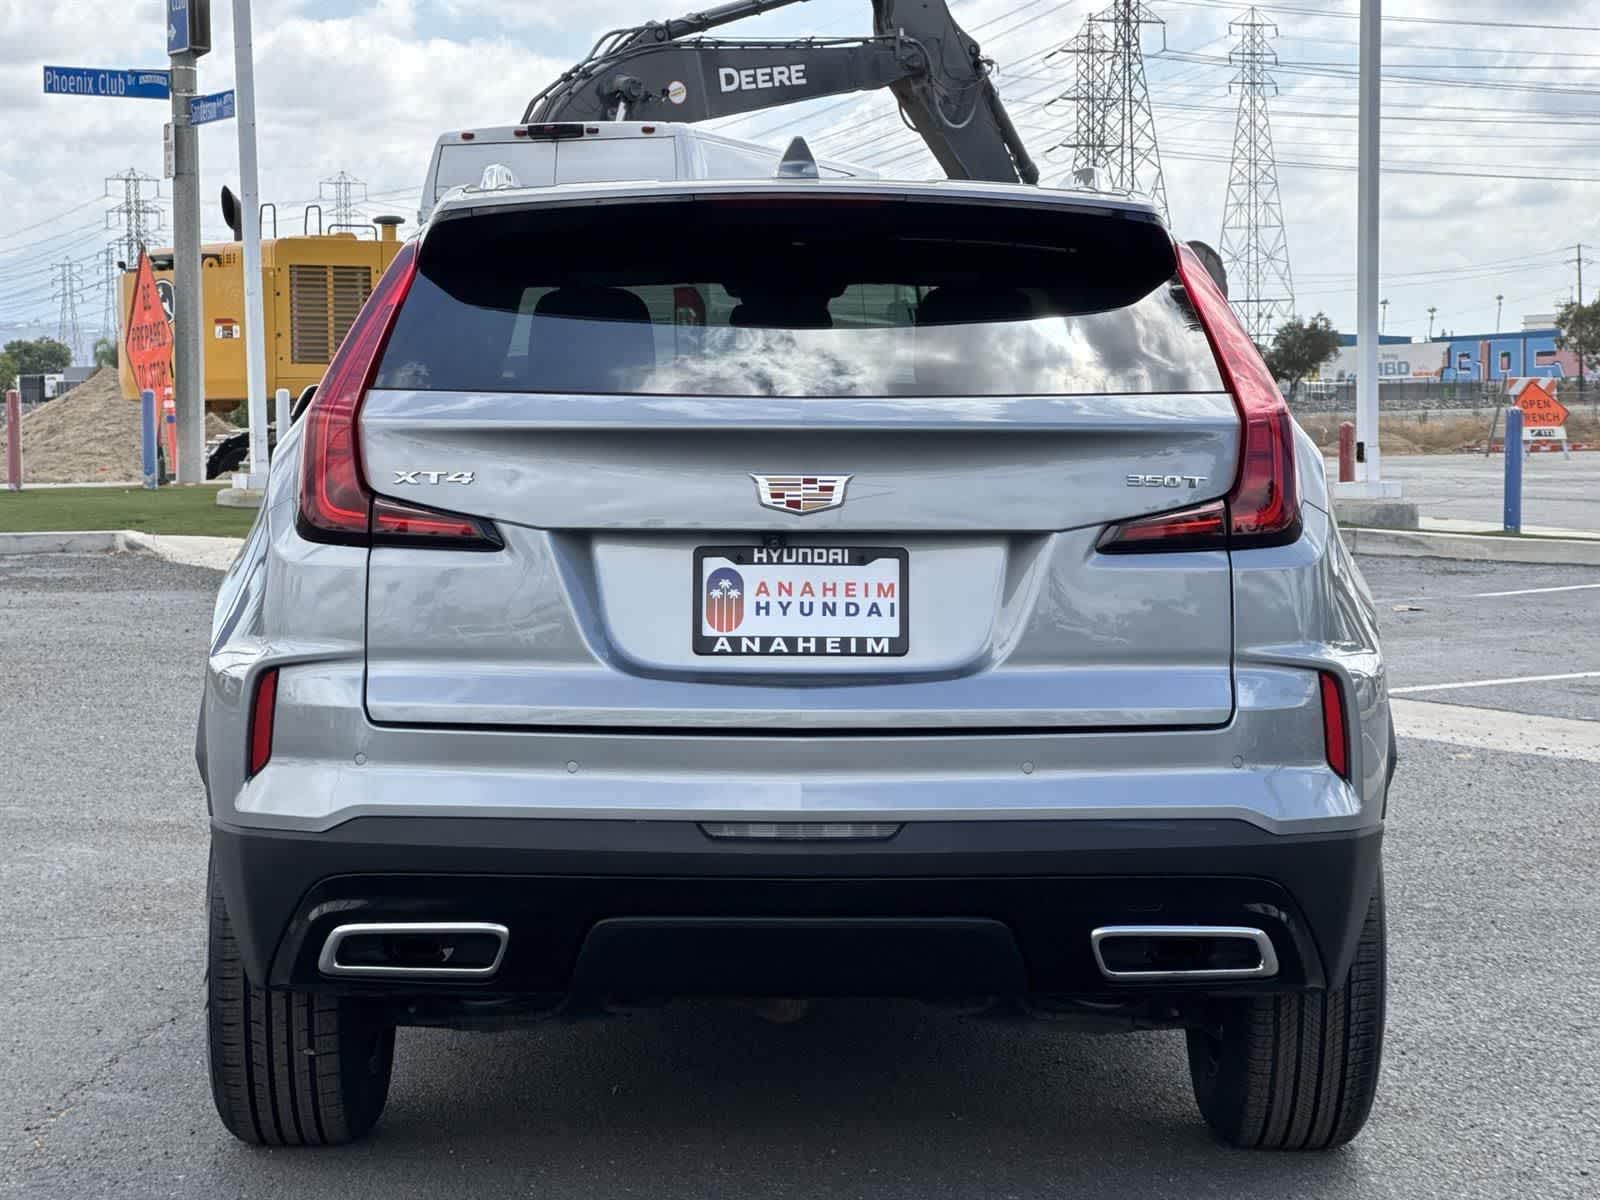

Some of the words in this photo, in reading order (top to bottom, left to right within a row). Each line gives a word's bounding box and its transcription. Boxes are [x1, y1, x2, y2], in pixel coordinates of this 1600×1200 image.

[45, 70, 94, 93] Phoenix
[98, 73, 126, 95] Club
[718, 64, 807, 92] DEERE
[1521, 399, 1551, 409] OPEN
[1523, 412, 1560, 423] RENCH
[392, 471, 475, 485] XT4
[1126, 474, 1208, 488] 350T
[753, 548, 849, 564] HYUNDAI
[755, 581, 895, 598] ANAHEIM
[755, 601, 895, 617] HYUNDAI
[713, 637, 889, 653] ANAHEIM
